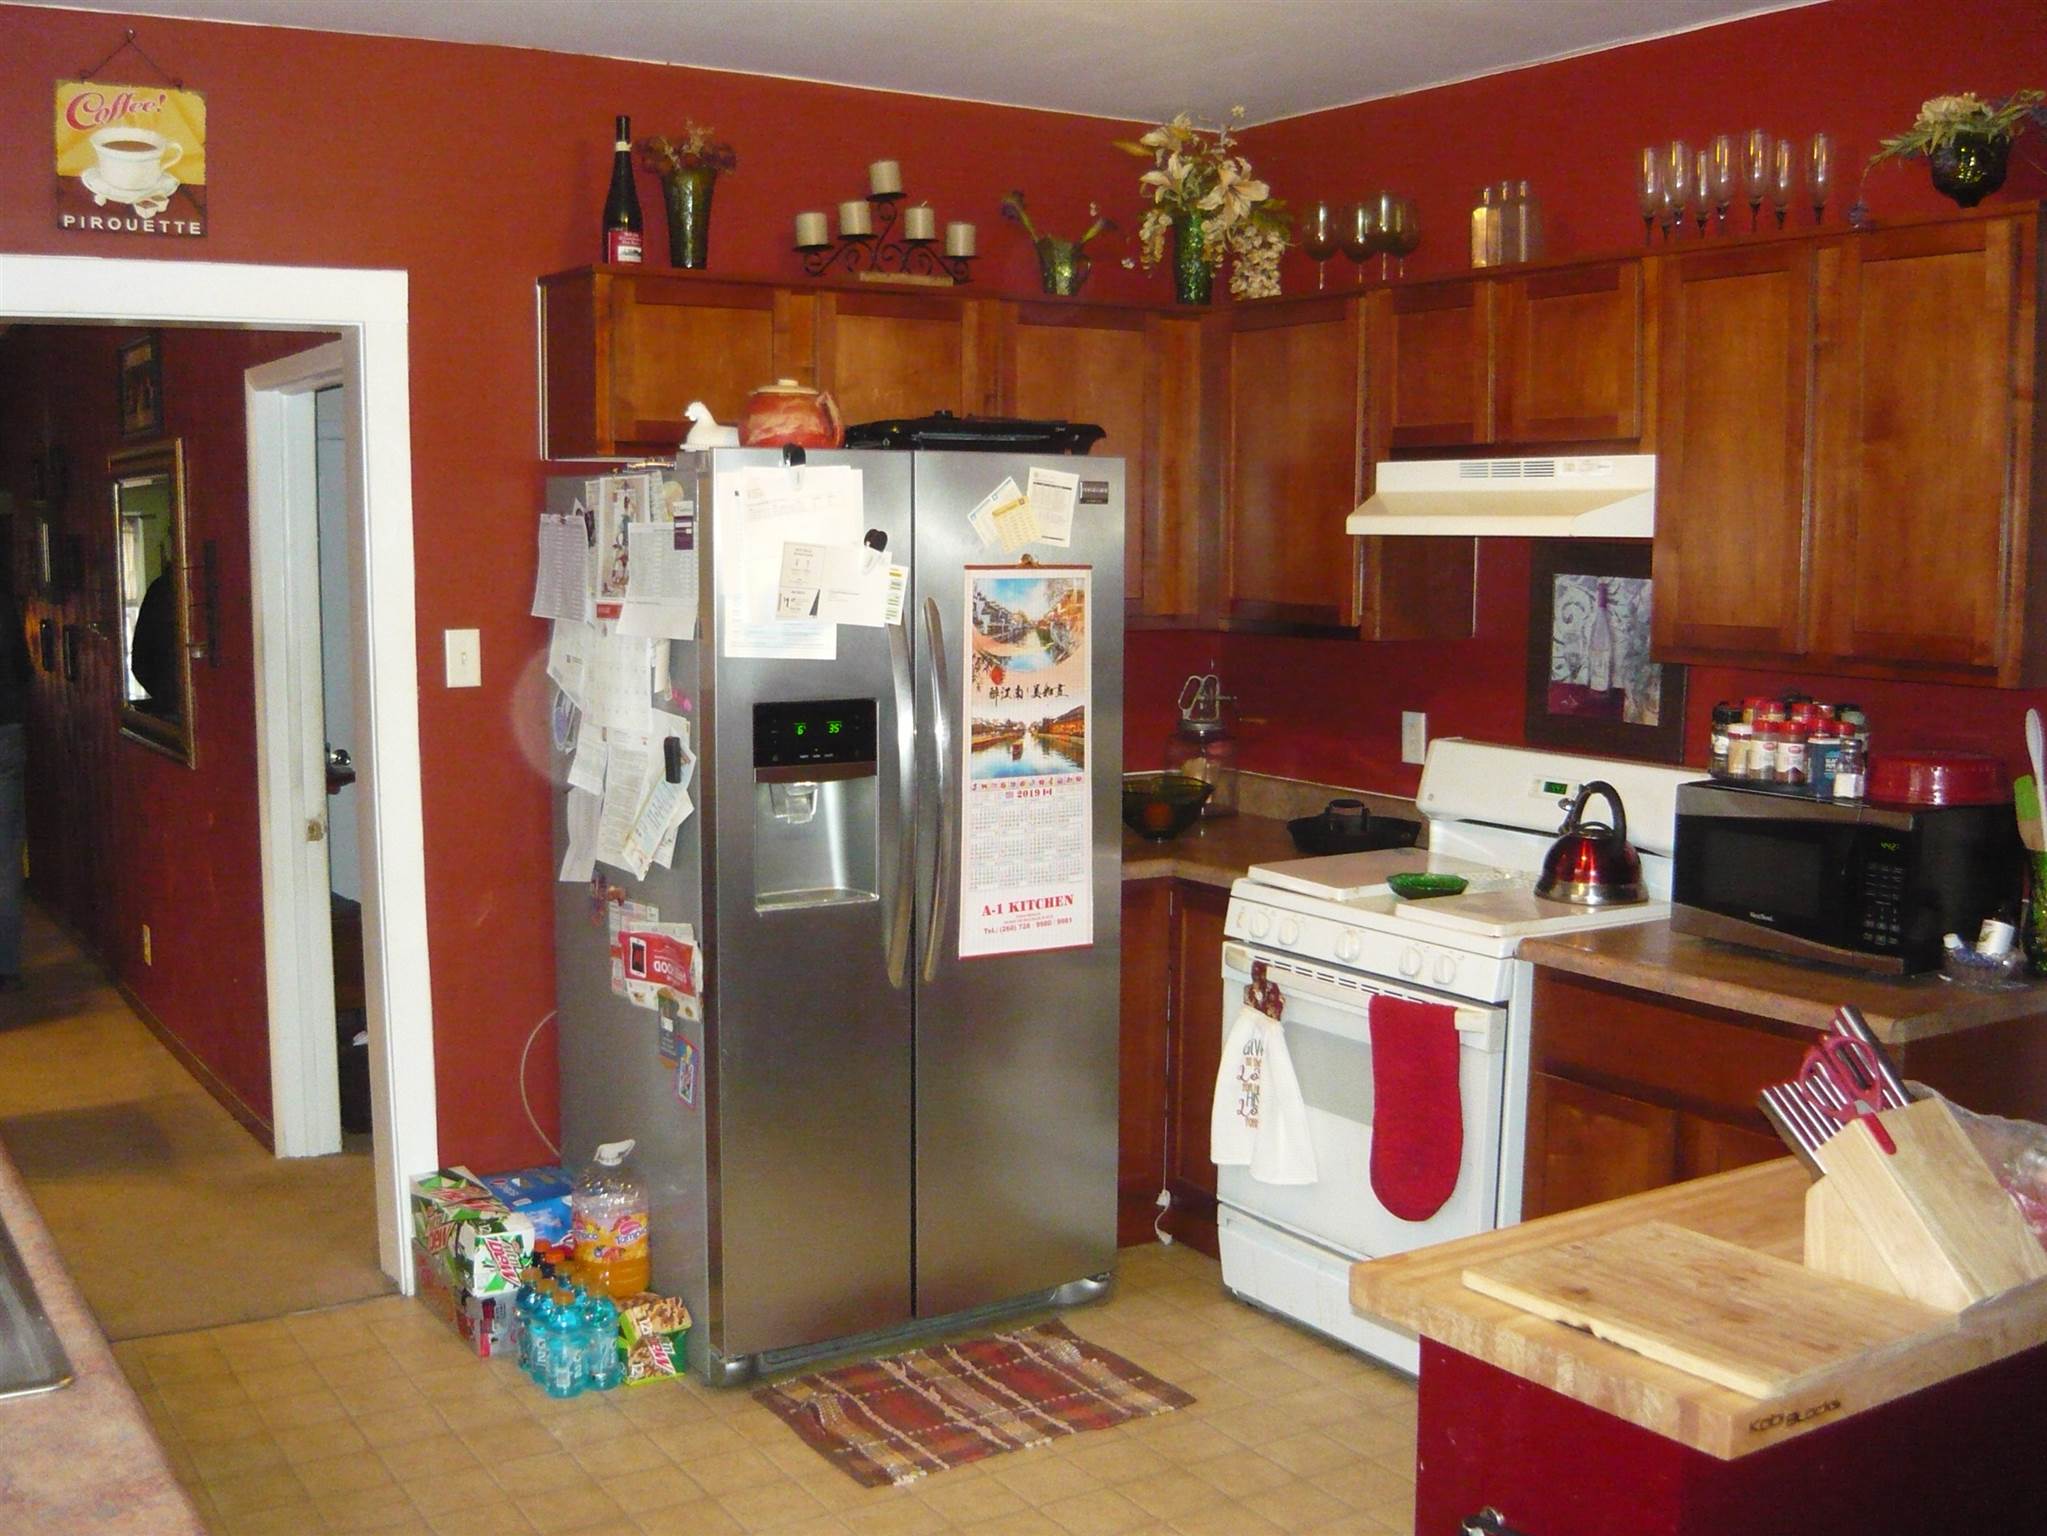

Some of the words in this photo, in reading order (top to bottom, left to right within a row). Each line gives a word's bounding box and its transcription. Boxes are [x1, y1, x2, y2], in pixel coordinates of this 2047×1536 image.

[65, 91, 166, 131] Coffee!
[63, 214, 202, 235] PIROUETTE
[1016, 788, 1041, 798] 2019
[982, 903, 1003, 916] A-1
[1008, 894, 1074, 913] KITCHEN
